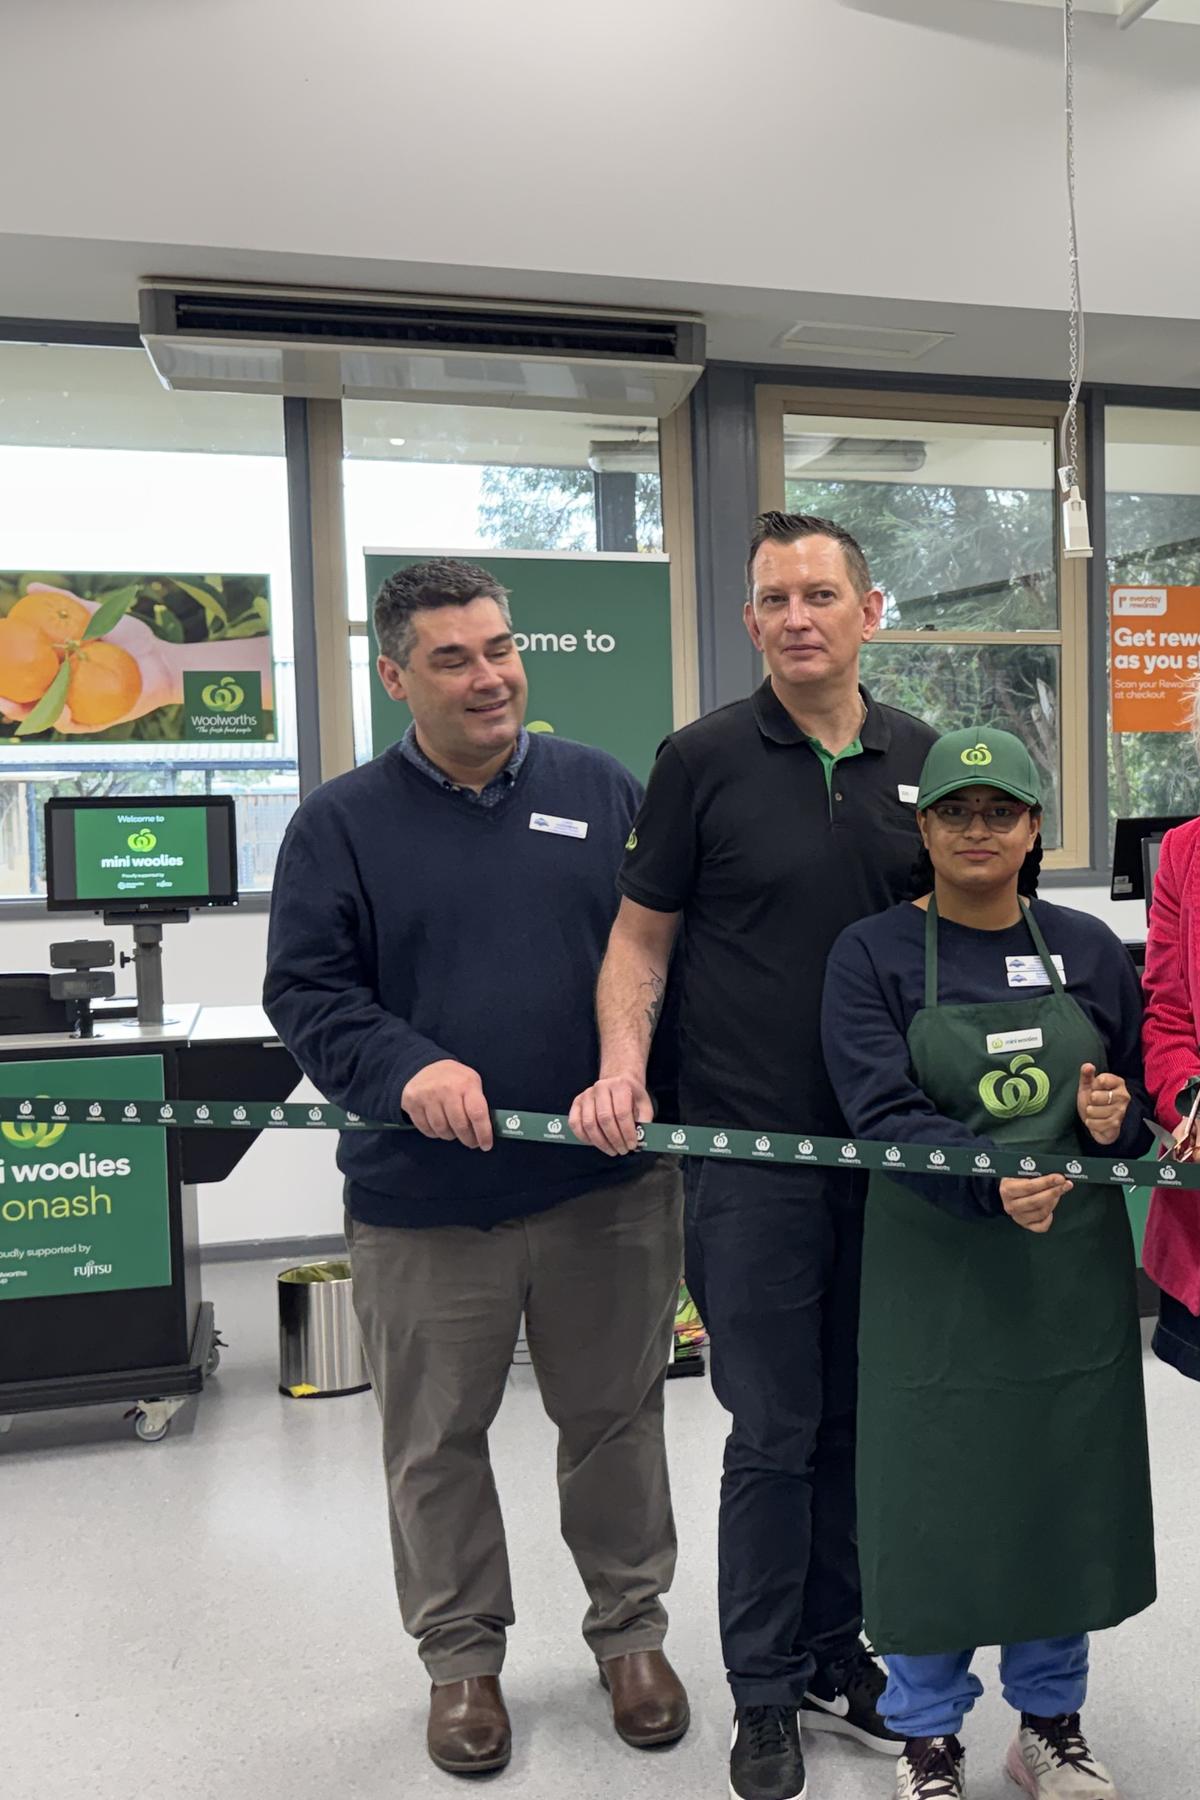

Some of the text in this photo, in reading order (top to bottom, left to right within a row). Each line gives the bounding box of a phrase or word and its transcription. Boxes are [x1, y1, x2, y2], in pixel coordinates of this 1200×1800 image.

[584, 629, 616, 652] to
[1114, 627, 1156, 647] Get
[1114, 654, 1141, 670] as
[1143, 654, 1183, 675] you
[1114, 680, 1138, 689] Scan
[1138, 682, 1158, 691] your
[1126, 690, 1166, 699] checkout
[117, 815, 155, 823] Welcome
[101, 853, 184, 868] mini woolies
[11, 1153, 132, 1183] woolies
[2, 1185, 112, 1222] onash
[0, 1243, 92, 1260] oudly supported by
[73, 1263, 112, 1278] FUJITSU
